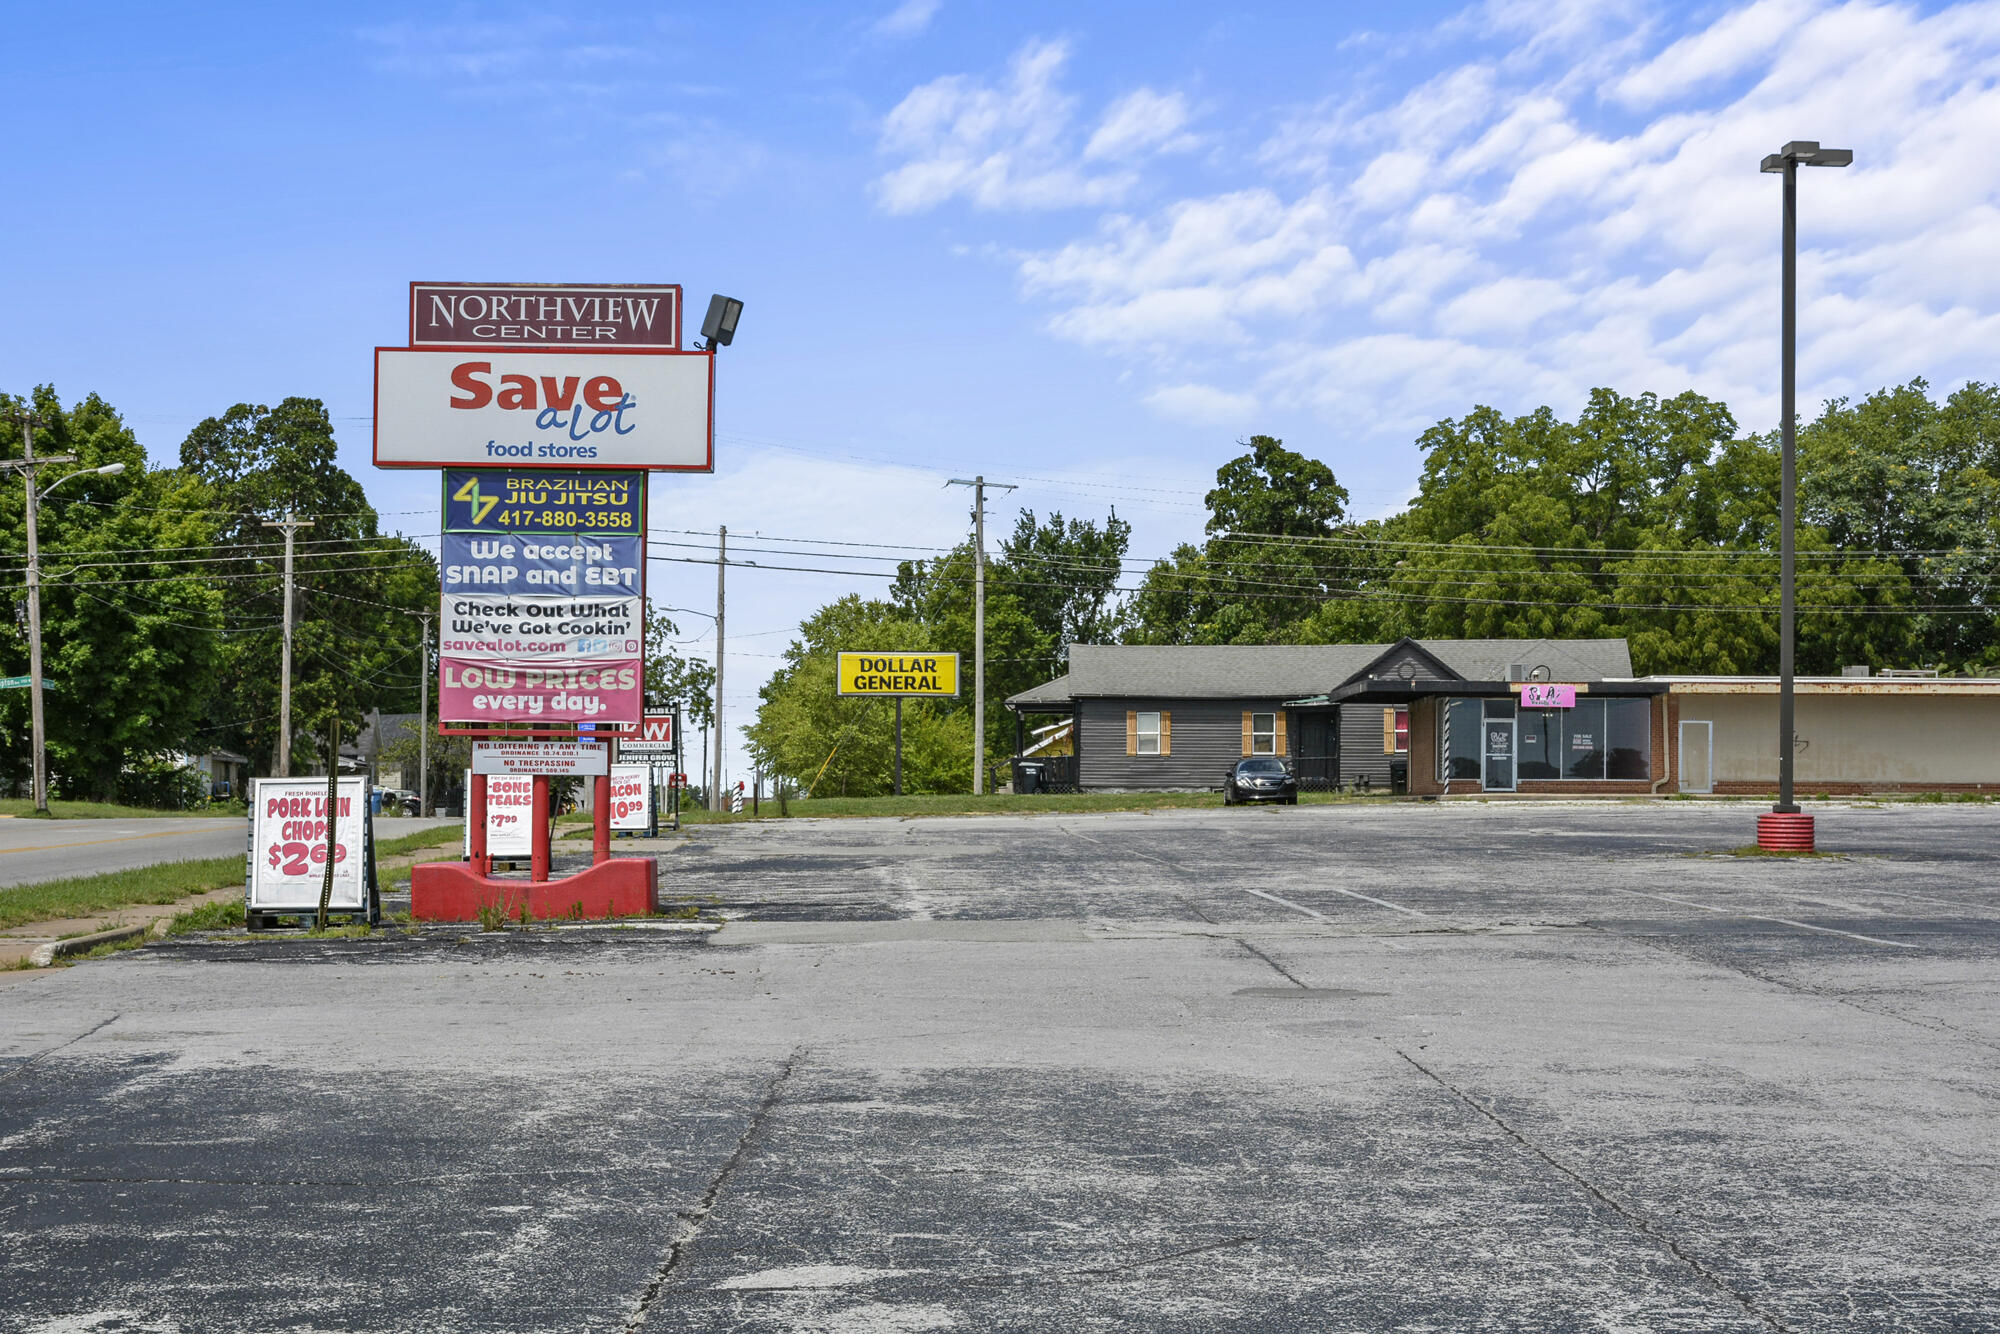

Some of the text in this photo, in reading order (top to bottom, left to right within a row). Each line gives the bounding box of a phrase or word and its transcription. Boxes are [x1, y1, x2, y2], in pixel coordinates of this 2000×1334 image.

[429, 294, 660, 331] NORTHVIEW
[472, 325, 617, 340] CENTER
[449, 361, 624, 412] Save
[486, 440, 598, 458] food stores
[506, 478, 629, 491] BRAZILIAN
[504, 491, 628, 506] JIU JITSU
[498, 510, 632, 528] 417-880-3558
[470, 540, 613, 564] We accept
[446, 565, 638, 586] SNAP and EBT
[454, 601, 630, 618] Check Out What
[452, 620, 631, 635] We've Got Cookin'
[443, 639, 566, 653] savealot.com
[859, 658, 938, 673] DOLLAR
[445, 667, 636, 690] LOW PRICES
[853, 675, 943, 690] GENERAL
[472, 691, 607, 715] every day.
[488, 781, 531, 793] -BONE
[610, 783, 642, 797] ACON
[267, 797, 312, 818] PORK
[487, 794, 532, 806] TEAKS
